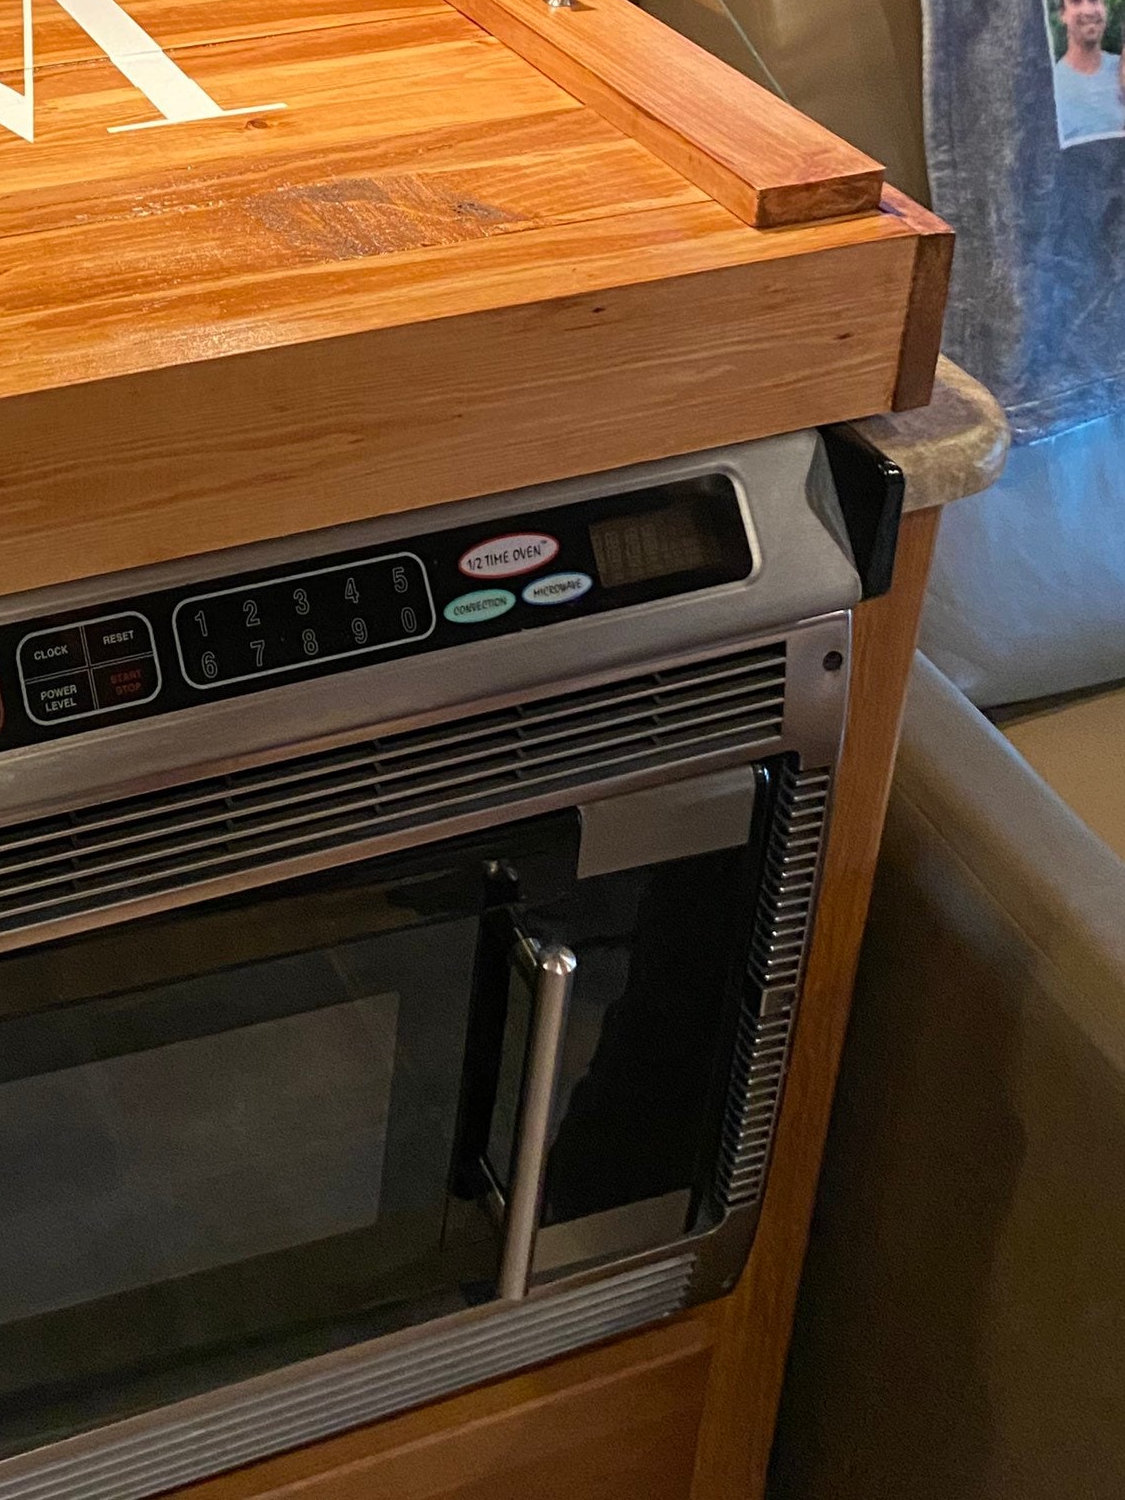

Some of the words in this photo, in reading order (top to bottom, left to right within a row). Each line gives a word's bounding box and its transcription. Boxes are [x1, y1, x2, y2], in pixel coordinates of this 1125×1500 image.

[484, 550, 510, 566] TIME
[532, 578, 583, 598] MICROWAVE
[194, 610, 210, 638] 1
[242, 600, 261, 627] 2
[292, 588, 310, 615] 3
[344, 578, 360, 604] 4
[391, 566, 409, 593] 5
[452, 596, 508, 617] CONVECTION
[102, 630, 135, 646] RESET
[201, 651, 219, 678] 6
[250, 640, 266, 667] 7
[302, 629, 319, 655] 8
[350, 617, 368, 644] 9
[400, 606, 417, 633] 0
[33, 644, 69, 662] CLOCK
[40, 684, 78, 702] POWER
[45, 699, 78, 714] LEVEL
